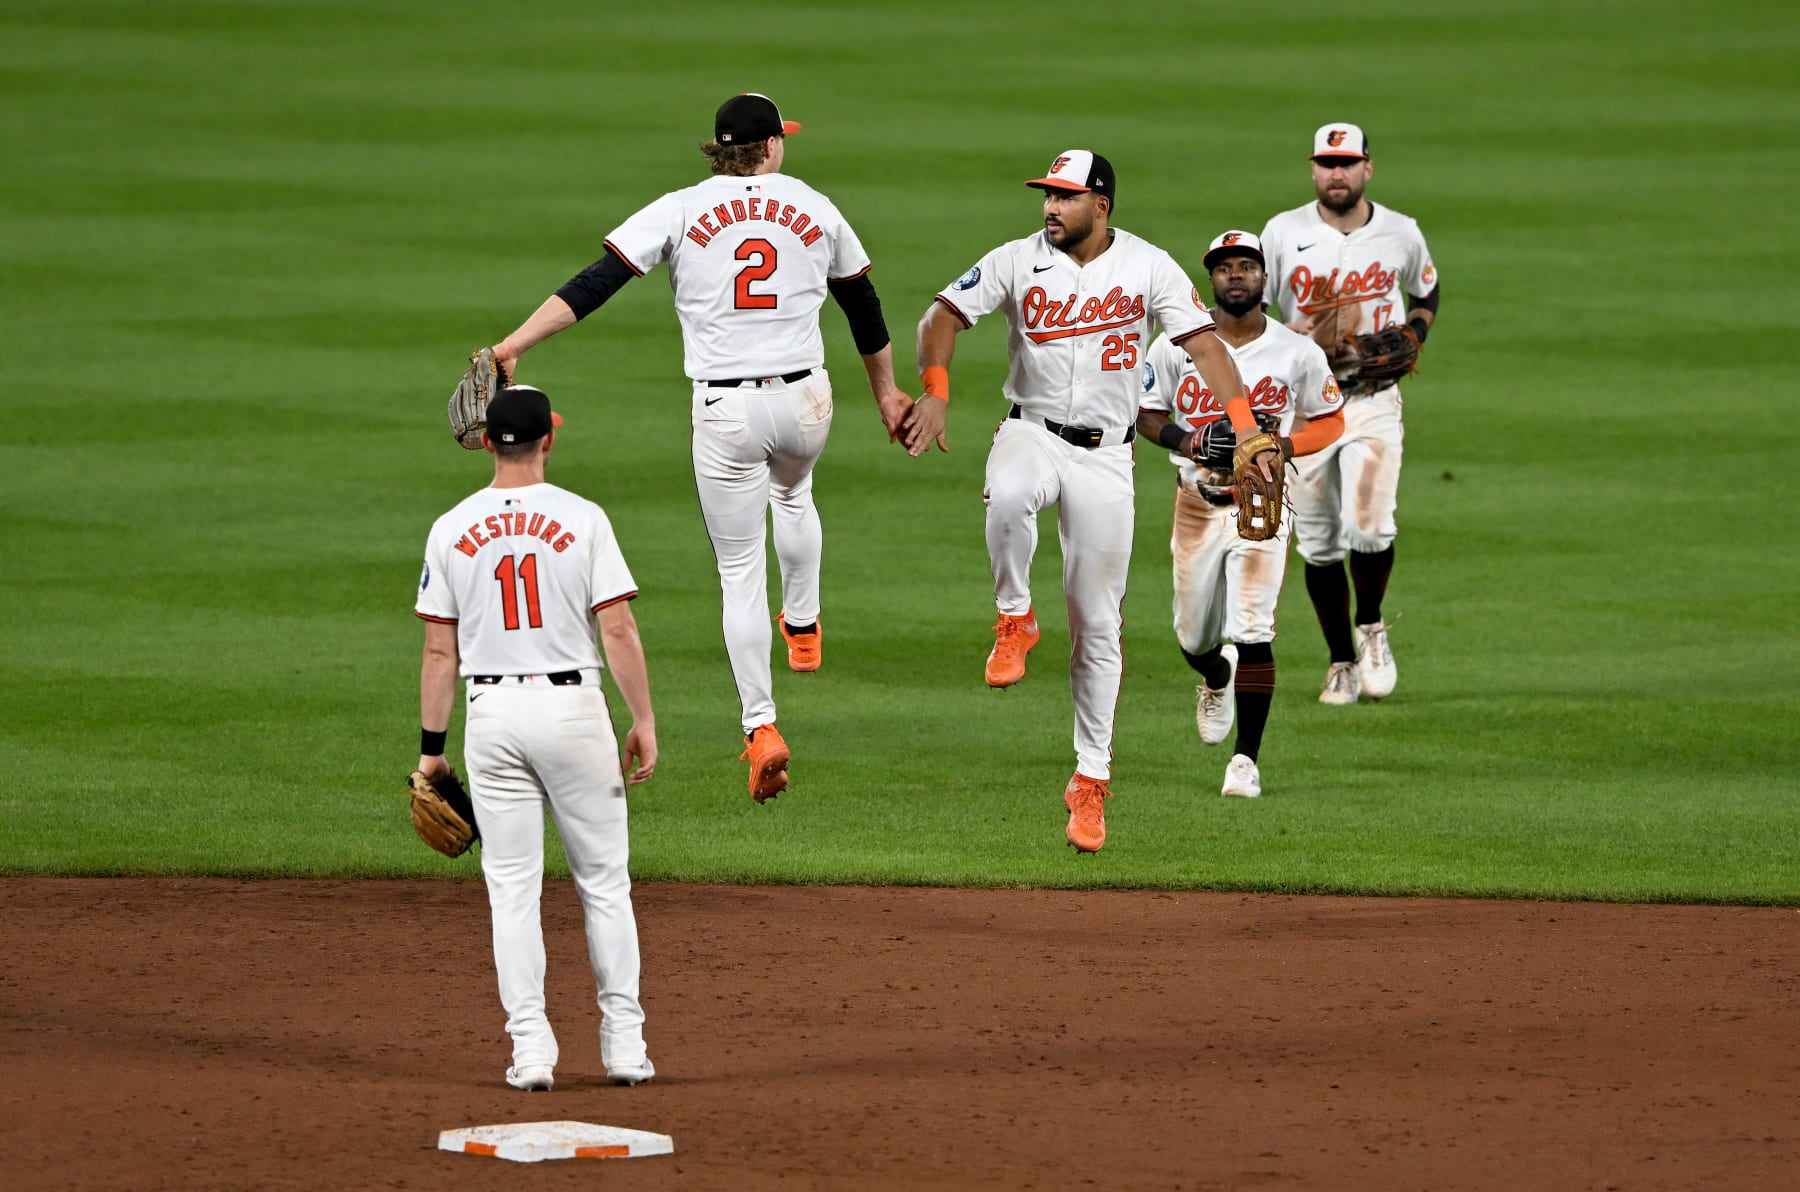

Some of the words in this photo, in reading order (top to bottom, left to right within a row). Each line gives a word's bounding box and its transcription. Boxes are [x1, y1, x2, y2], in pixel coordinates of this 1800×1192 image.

[686, 197, 824, 248] HENDERSON
[734, 238, 778, 310] 2
[1290, 261, 1397, 303] Orioles
[1023, 286, 1146, 330] Orioles
[1373, 304, 1393, 334] 17
[1101, 333, 1140, 371] 25
[1176, 375, 1288, 415] Orles
[454, 512, 576, 558] WESTBURG
[494, 553, 543, 631] 11
